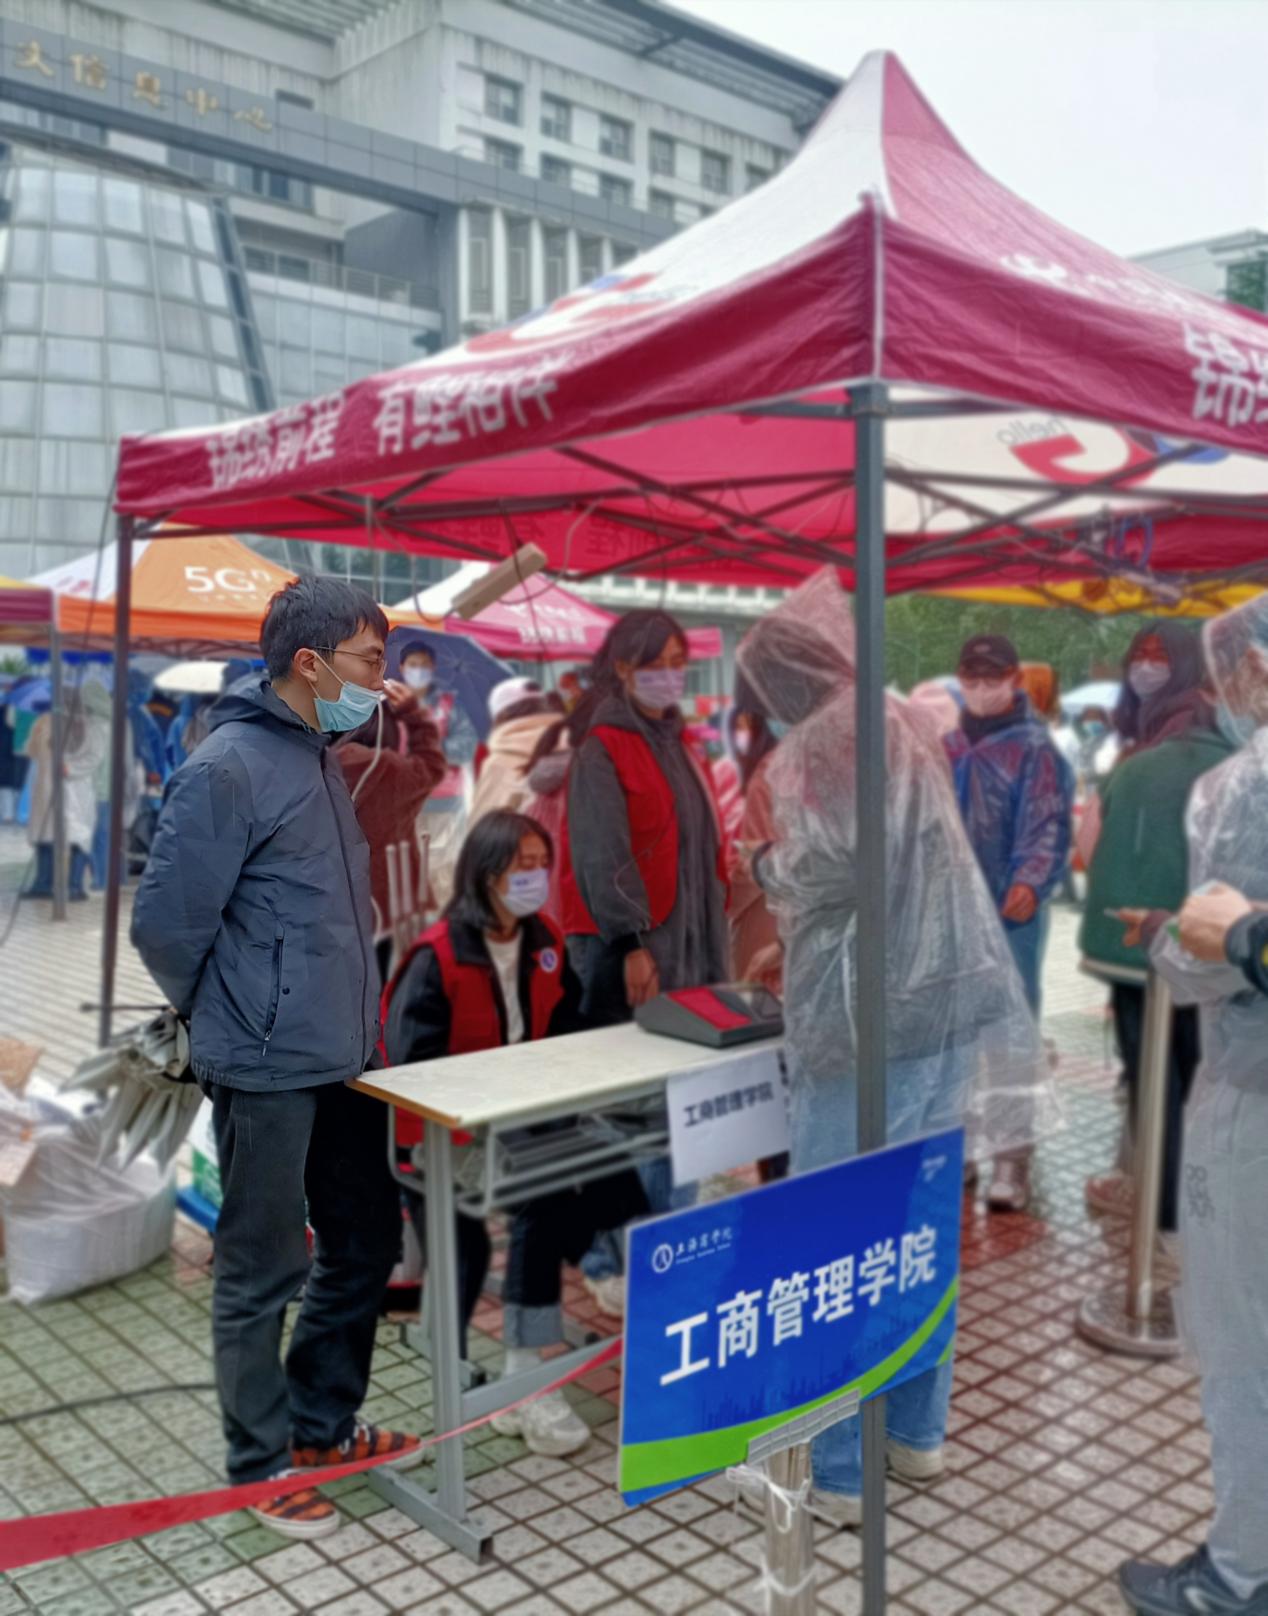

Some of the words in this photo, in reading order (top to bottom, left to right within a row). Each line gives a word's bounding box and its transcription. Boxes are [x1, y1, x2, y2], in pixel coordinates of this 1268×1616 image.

[15, 40, 273, 133] 文信息中心
[660, 1224, 937, 1386] 工商管理学院
